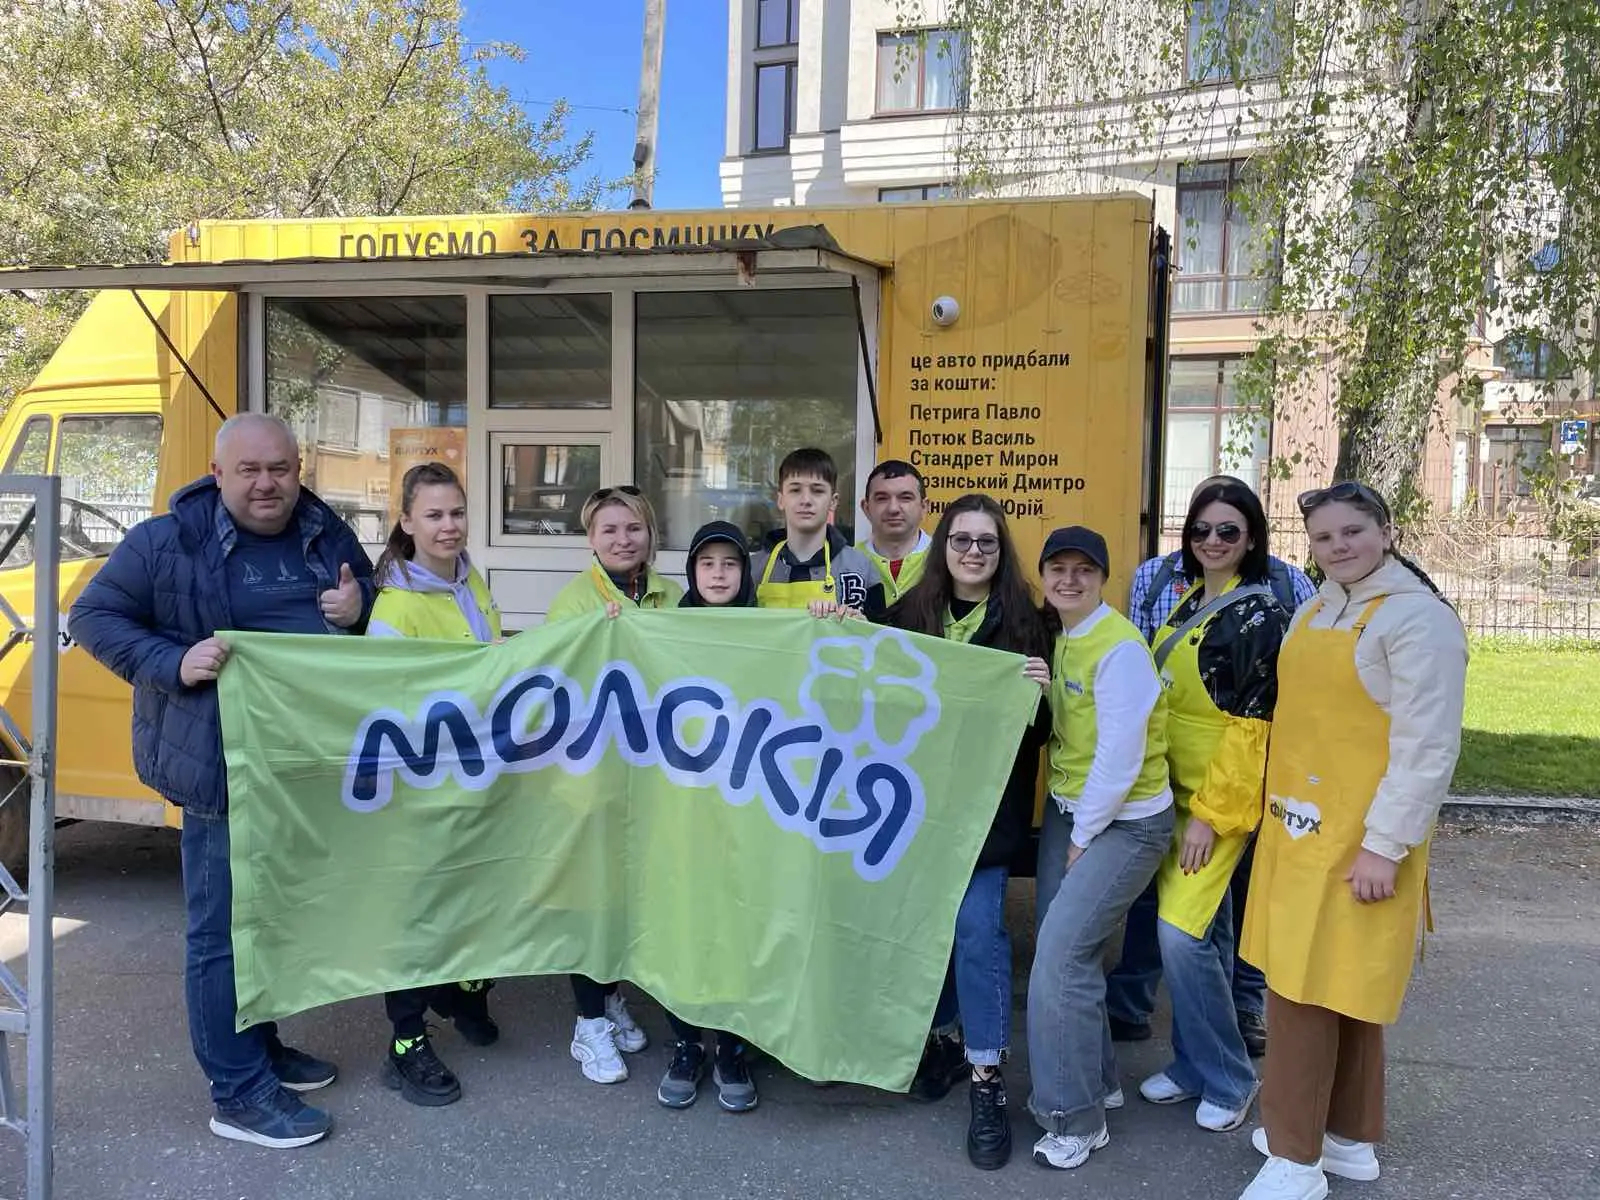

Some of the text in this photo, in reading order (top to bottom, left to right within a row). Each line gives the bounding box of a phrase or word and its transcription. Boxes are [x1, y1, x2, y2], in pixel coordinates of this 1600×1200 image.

[520, 228, 562, 252] ЗА
[910, 350, 1070, 371] це авто придбали
[910, 377, 996, 391] за кошти:
[910, 403, 1041, 423] Петрига Павло
[909, 429, 1036, 446] Потюк Василь
[910, 450, 1059, 471] Стандрет Мирон
[922, 472, 1086, 494] озінський Дмитро
[1001, 498, 1043, 519] Юрій
